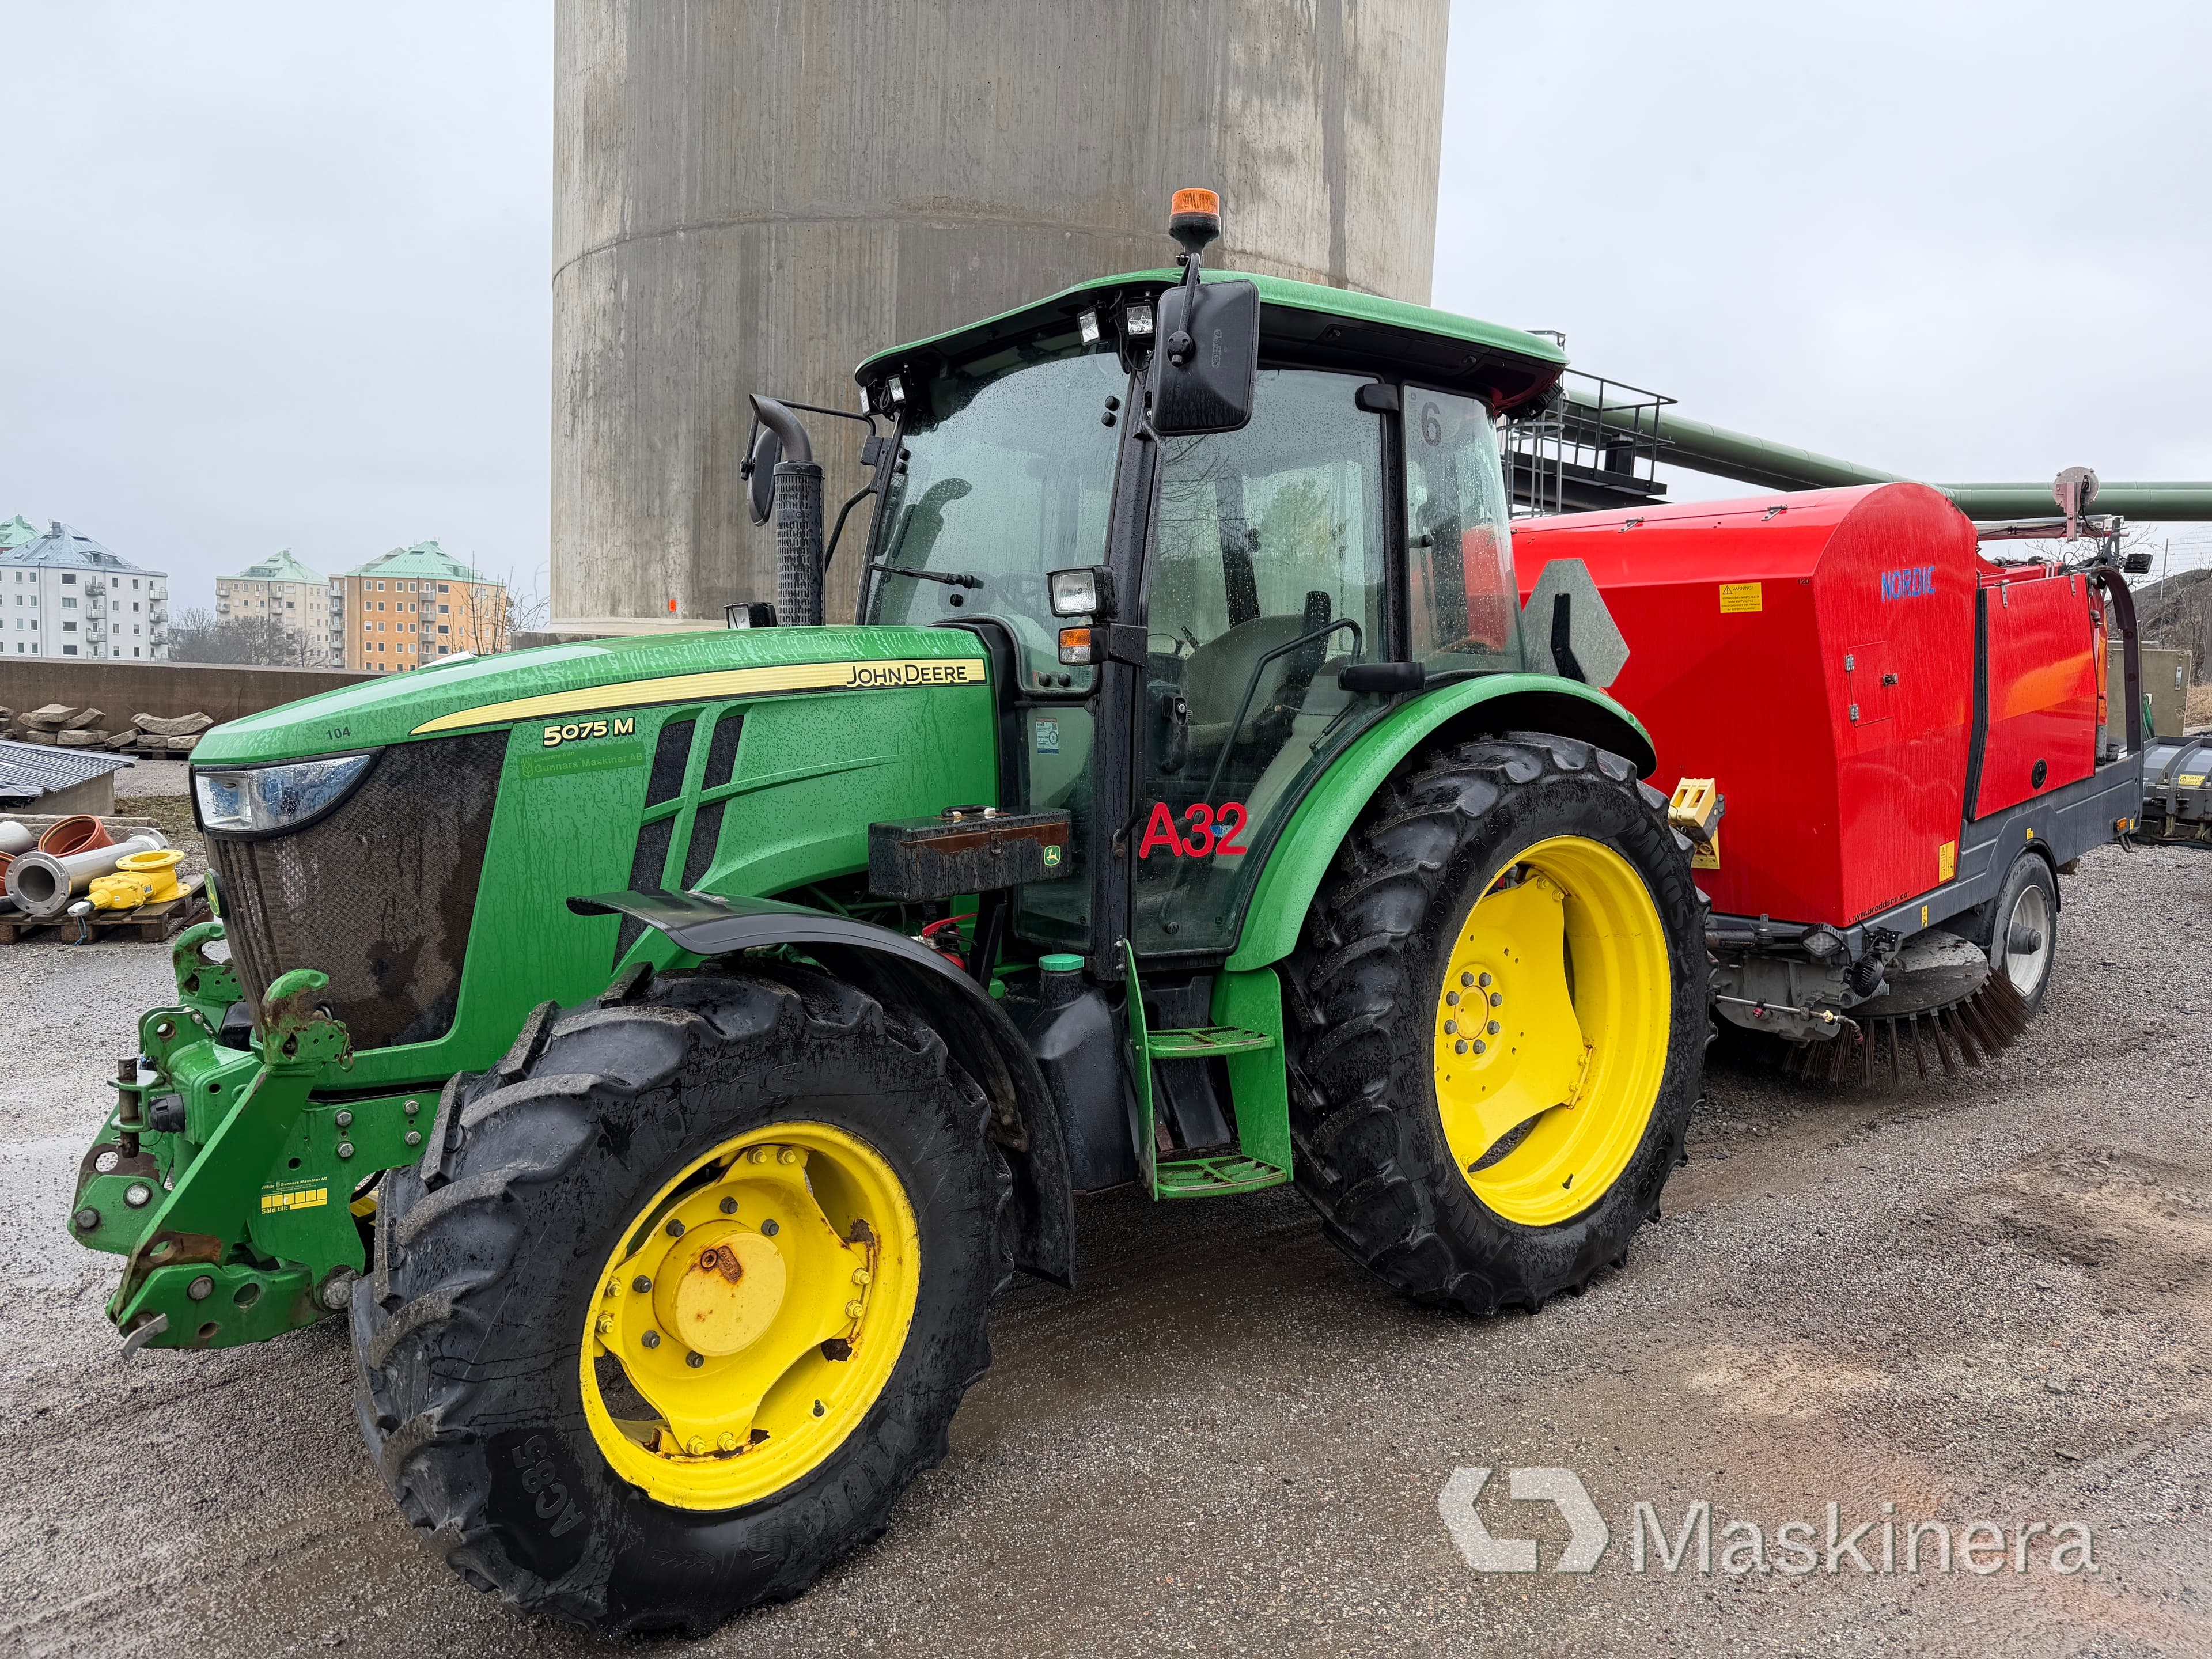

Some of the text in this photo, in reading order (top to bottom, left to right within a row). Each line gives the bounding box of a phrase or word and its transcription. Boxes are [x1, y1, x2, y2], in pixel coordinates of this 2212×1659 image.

[1421, 402, 1442, 447] 6
[1881, 566, 1935, 602] NORDIC
[846, 664, 967, 685] JOHN DEERE
[326, 726, 351, 740] 104
[543, 717, 635, 747] 5075 M
[534, 752, 643, 773] Gunnars Maskiner AB
[1138, 801, 1248, 858] A32
[1638, 1130, 1675, 1199] AC85
[261, 1206, 276, 1214] Såld
[512, 1434, 587, 1538] AC85
